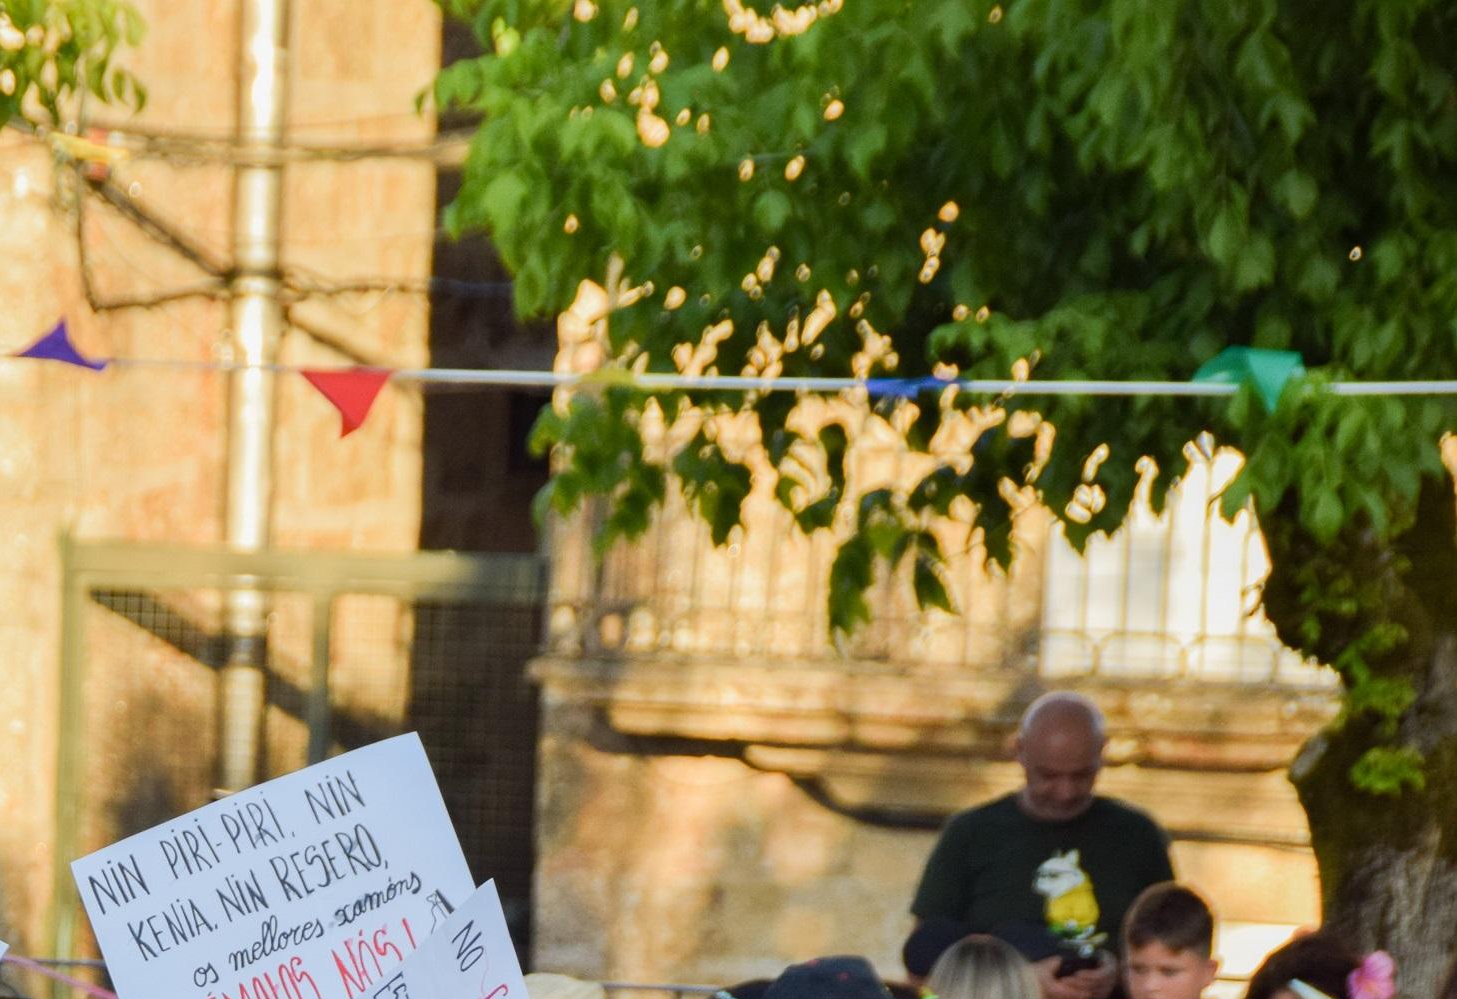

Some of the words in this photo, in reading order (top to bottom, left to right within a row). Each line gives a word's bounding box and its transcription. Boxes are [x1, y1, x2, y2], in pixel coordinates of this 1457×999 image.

[88, 854, 151, 915] NIN
[304, 769, 366, 825] NIN
[216, 869, 270, 923] NIN
[193, 962, 221, 988] os
[228, 915, 325, 972] mellores
[451, 919, 485, 973] NO
